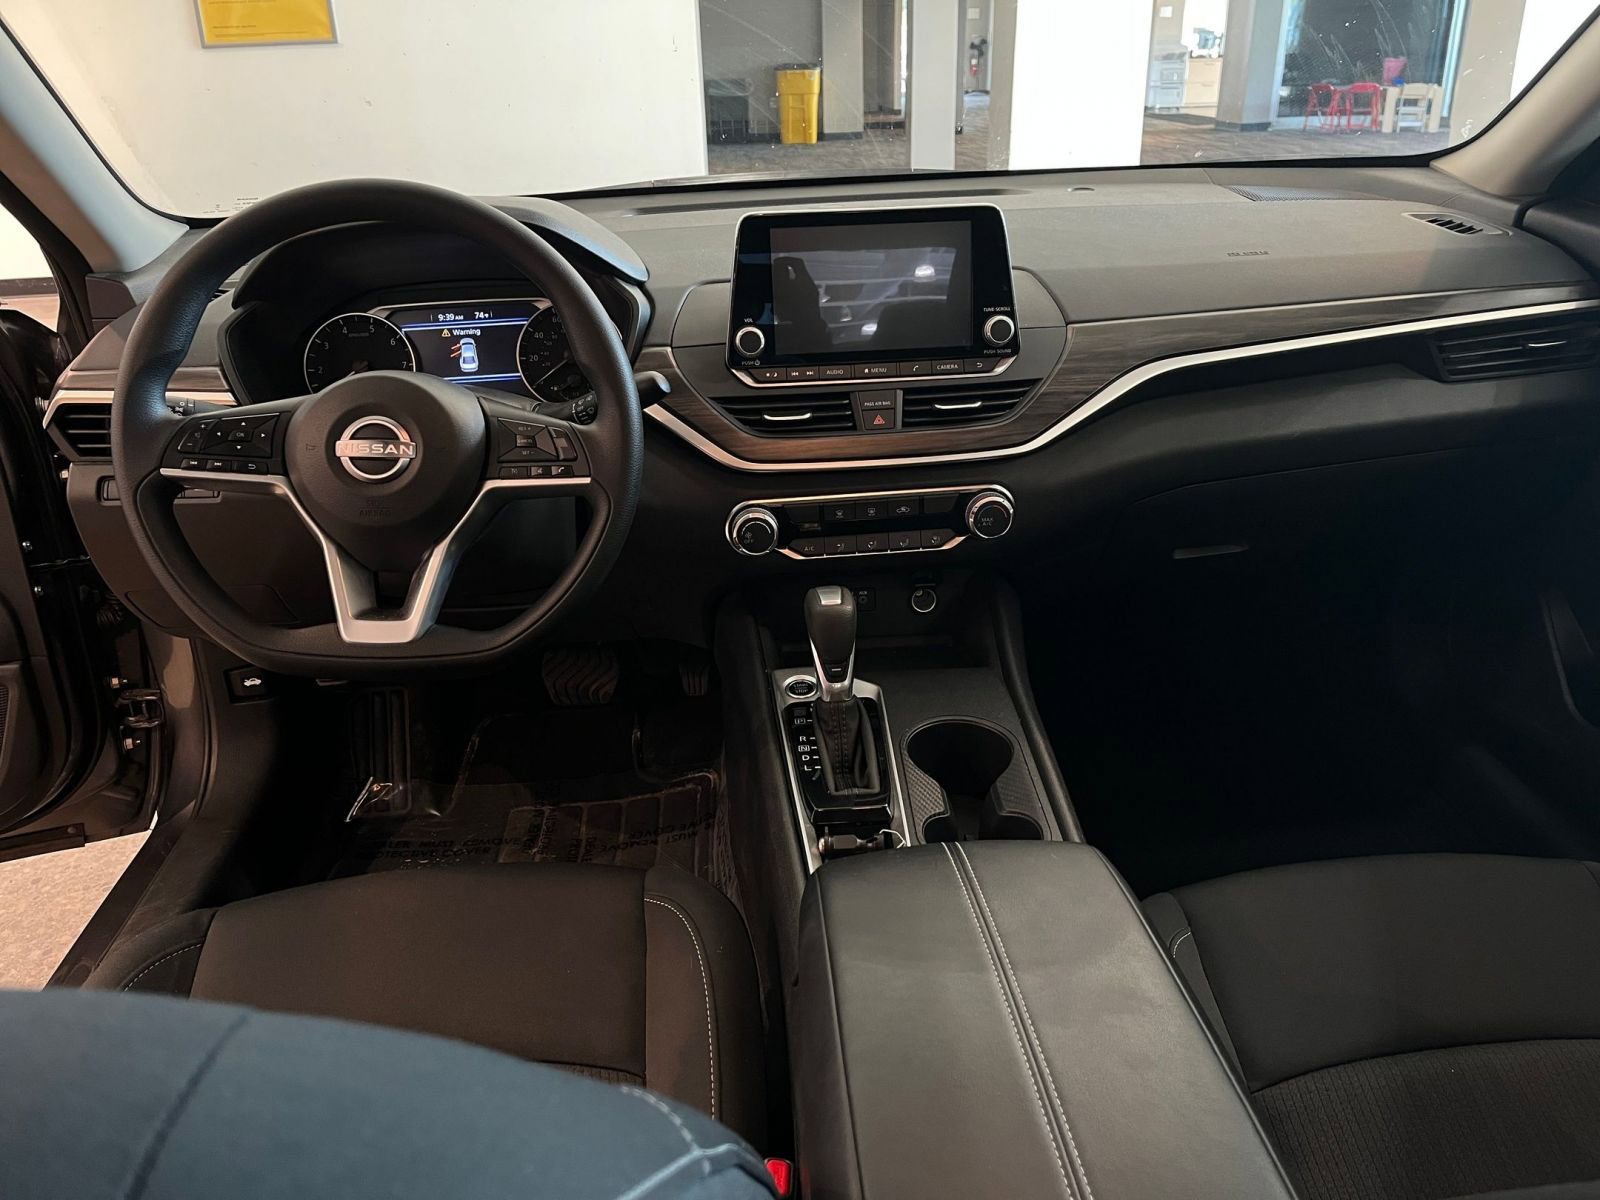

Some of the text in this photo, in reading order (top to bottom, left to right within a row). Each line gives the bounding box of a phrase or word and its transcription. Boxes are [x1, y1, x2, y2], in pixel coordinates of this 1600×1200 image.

[437, 313, 455, 321] 9:39
[452, 328, 481, 336] Warning
[529, 354, 539, 362] 20
[338, 442, 414, 456] NISSAN
